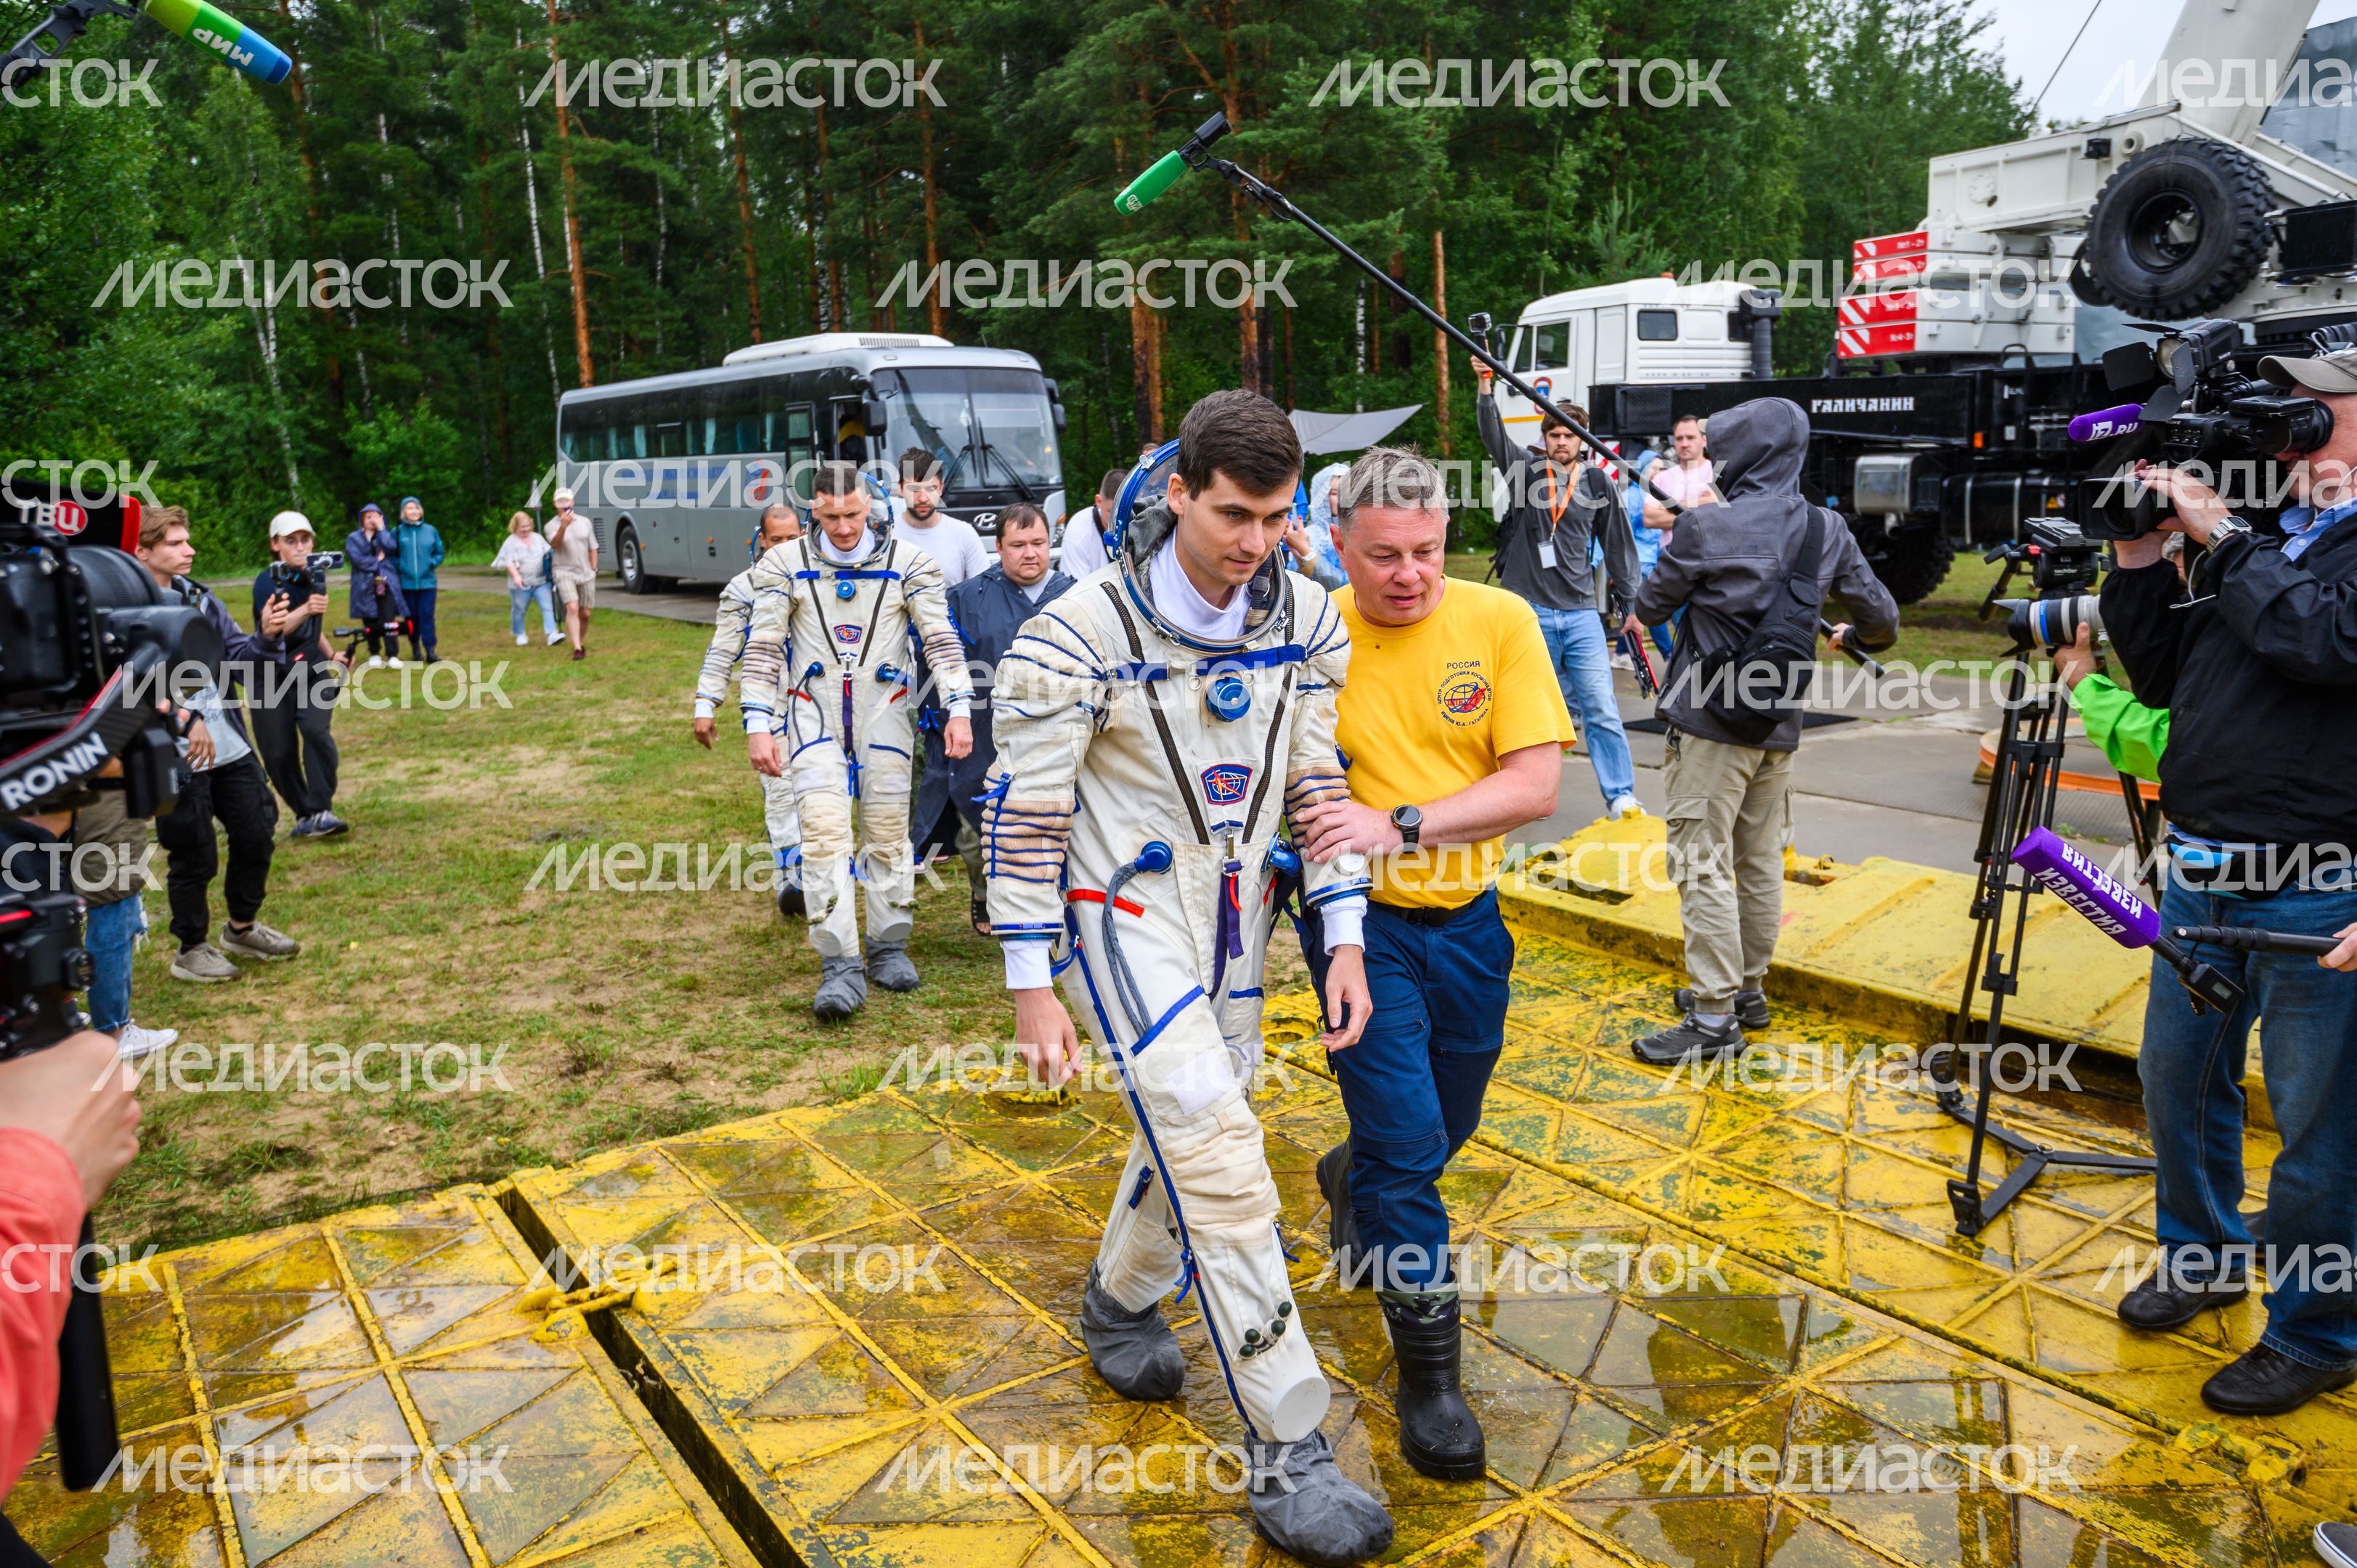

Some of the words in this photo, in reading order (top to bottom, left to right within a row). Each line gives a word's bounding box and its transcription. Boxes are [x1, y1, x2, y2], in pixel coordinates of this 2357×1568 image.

[192, 28, 255, 67] МИР
[1811, 396, 1916, 414] ГАЛИЧАНИН
[16, 499, 81, 533] ТВЦ
[1446, 661, 1481, 669] РОССИЯ
[1441, 671, 1470, 688] ПОДГОТОВКИ
[1471, 671, 1492, 701] КОСМОНАВТОВ
[1441, 711, 1455, 724] ИМЕНИ
[1468, 709, 1489, 726] ГАГАРИНА
[0, 731, 109, 812] RONIN
[2061, 842, 2143, 920] ИЗВЕСТИЯ
[2035, 867, 2128, 936] ИЗВЕСТИЯ
